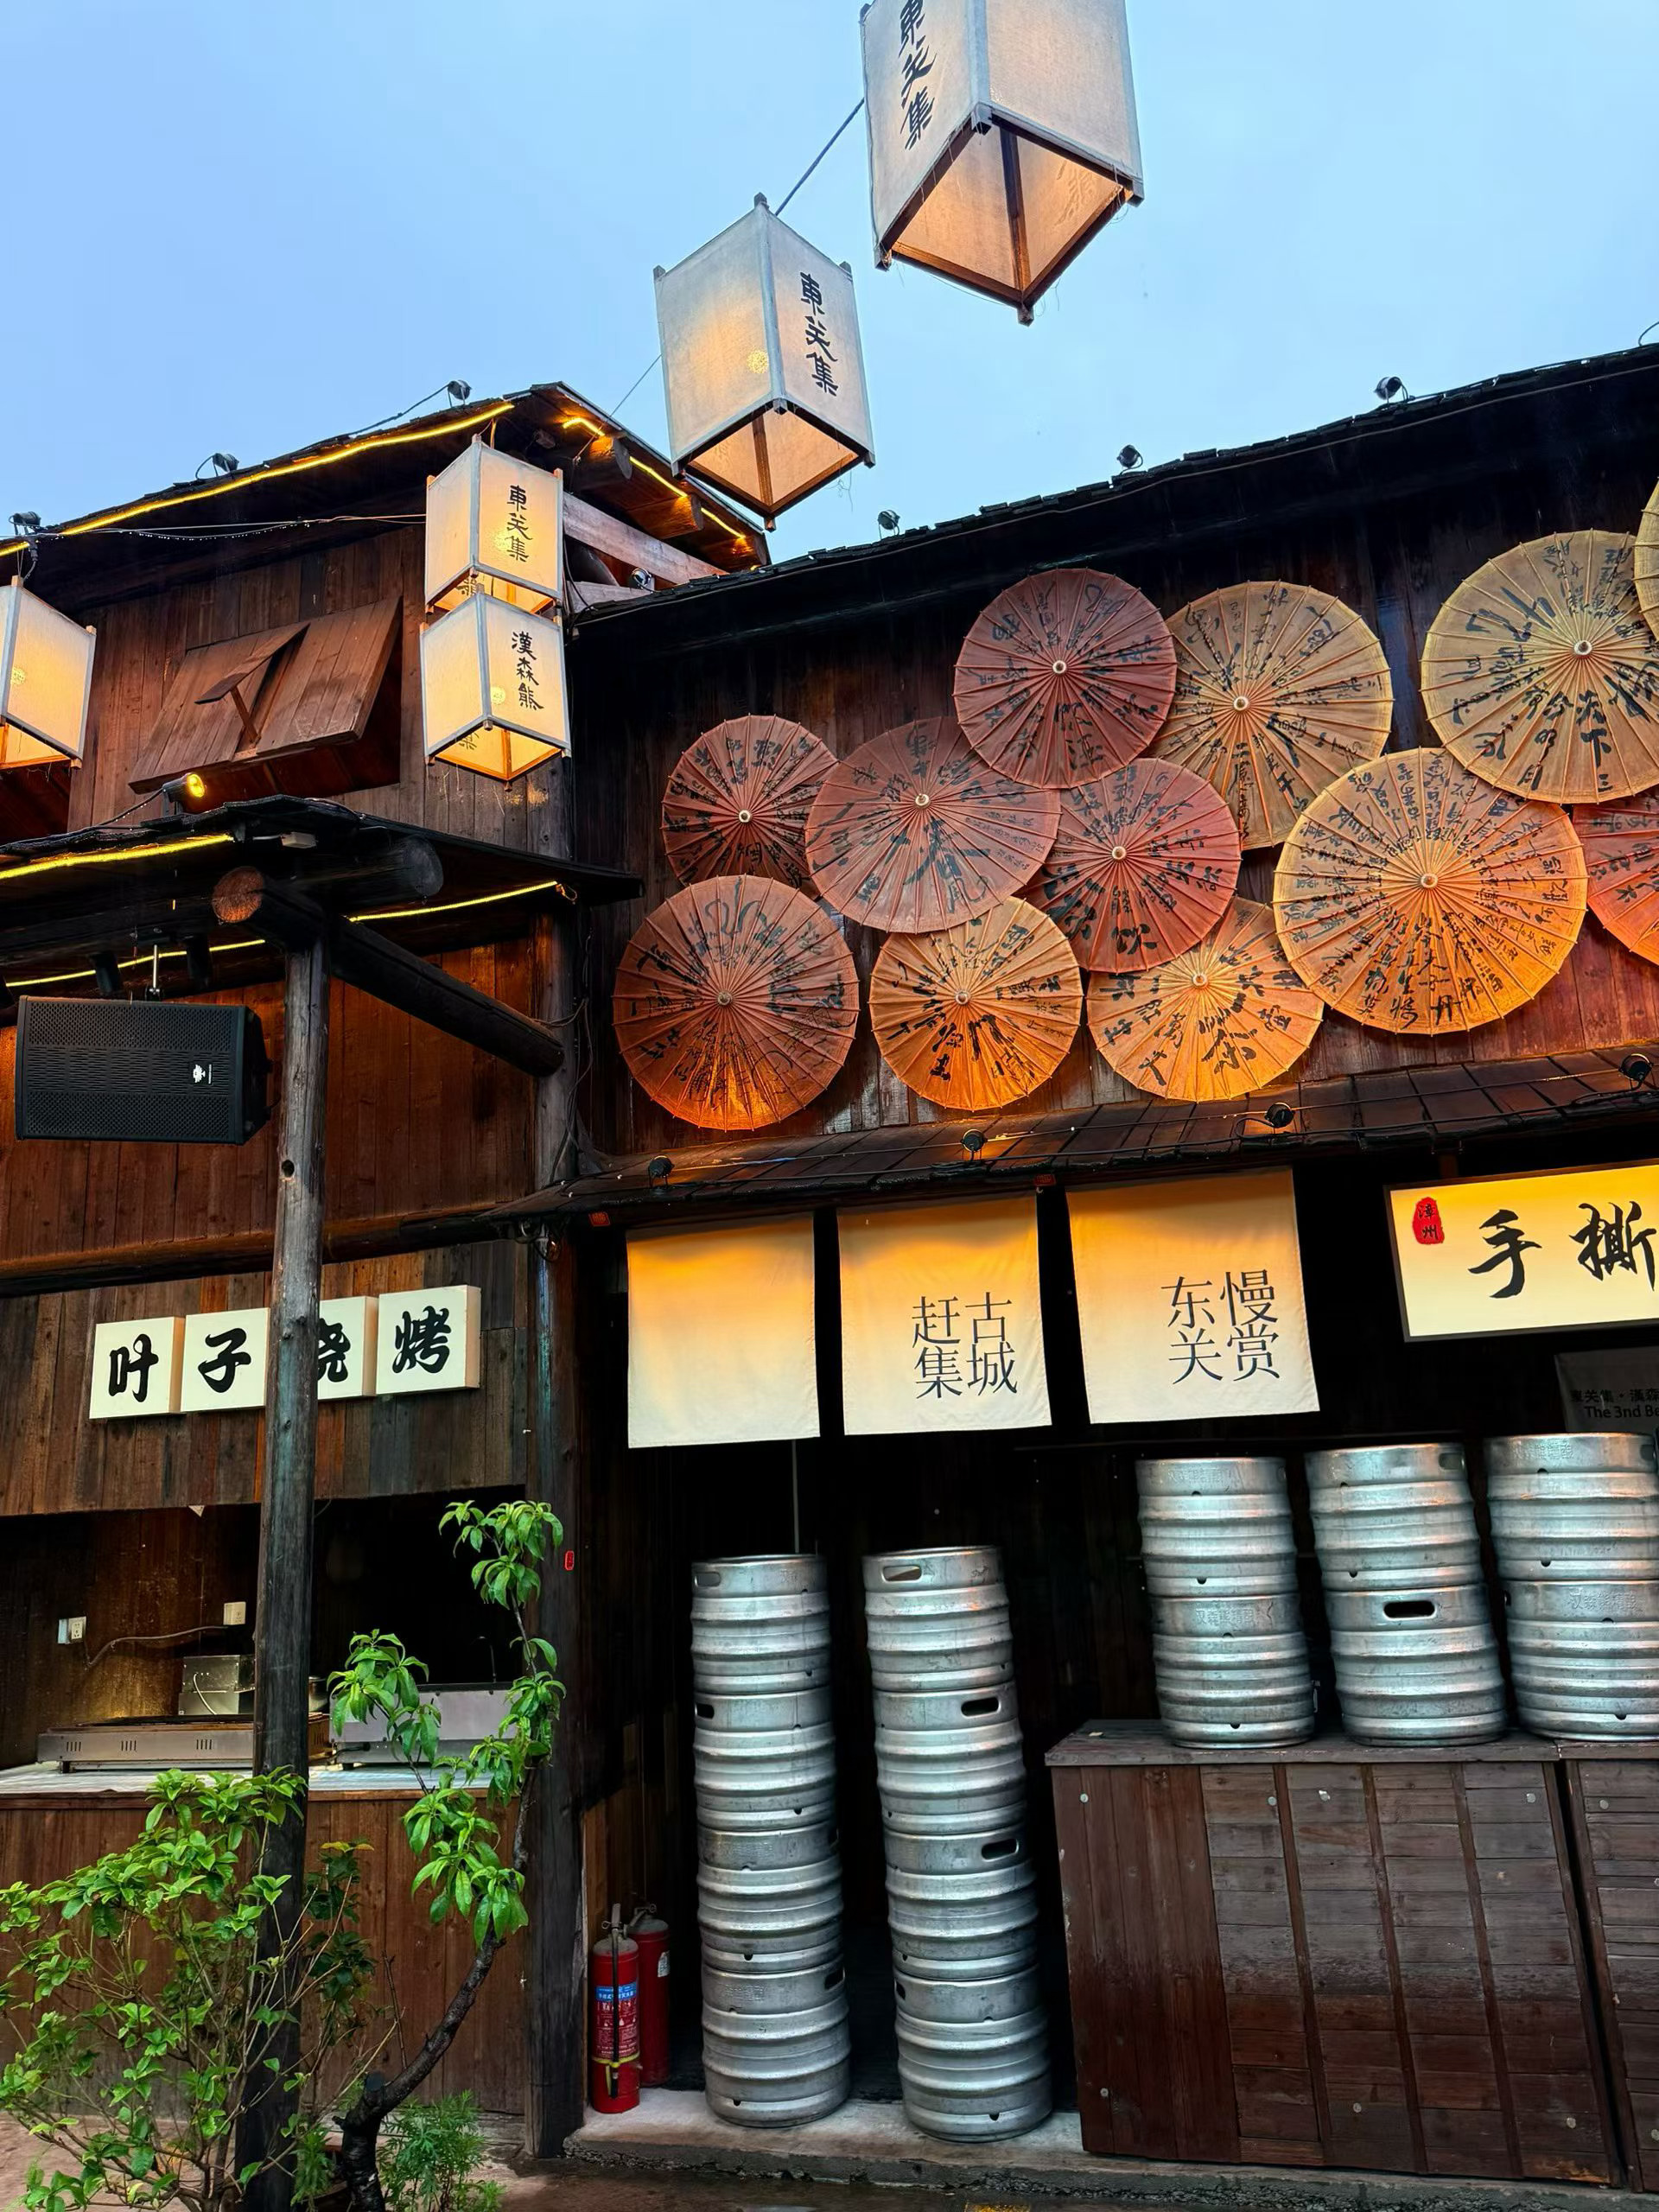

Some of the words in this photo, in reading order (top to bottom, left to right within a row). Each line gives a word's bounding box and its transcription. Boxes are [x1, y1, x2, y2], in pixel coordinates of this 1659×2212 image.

[912, 1295, 963, 1400] 赶集
[964, 1291, 1018, 1396] 古城
[1160, 1275, 1223, 1385] 东关
[1219, 1268, 1280, 1382] 慢赏
